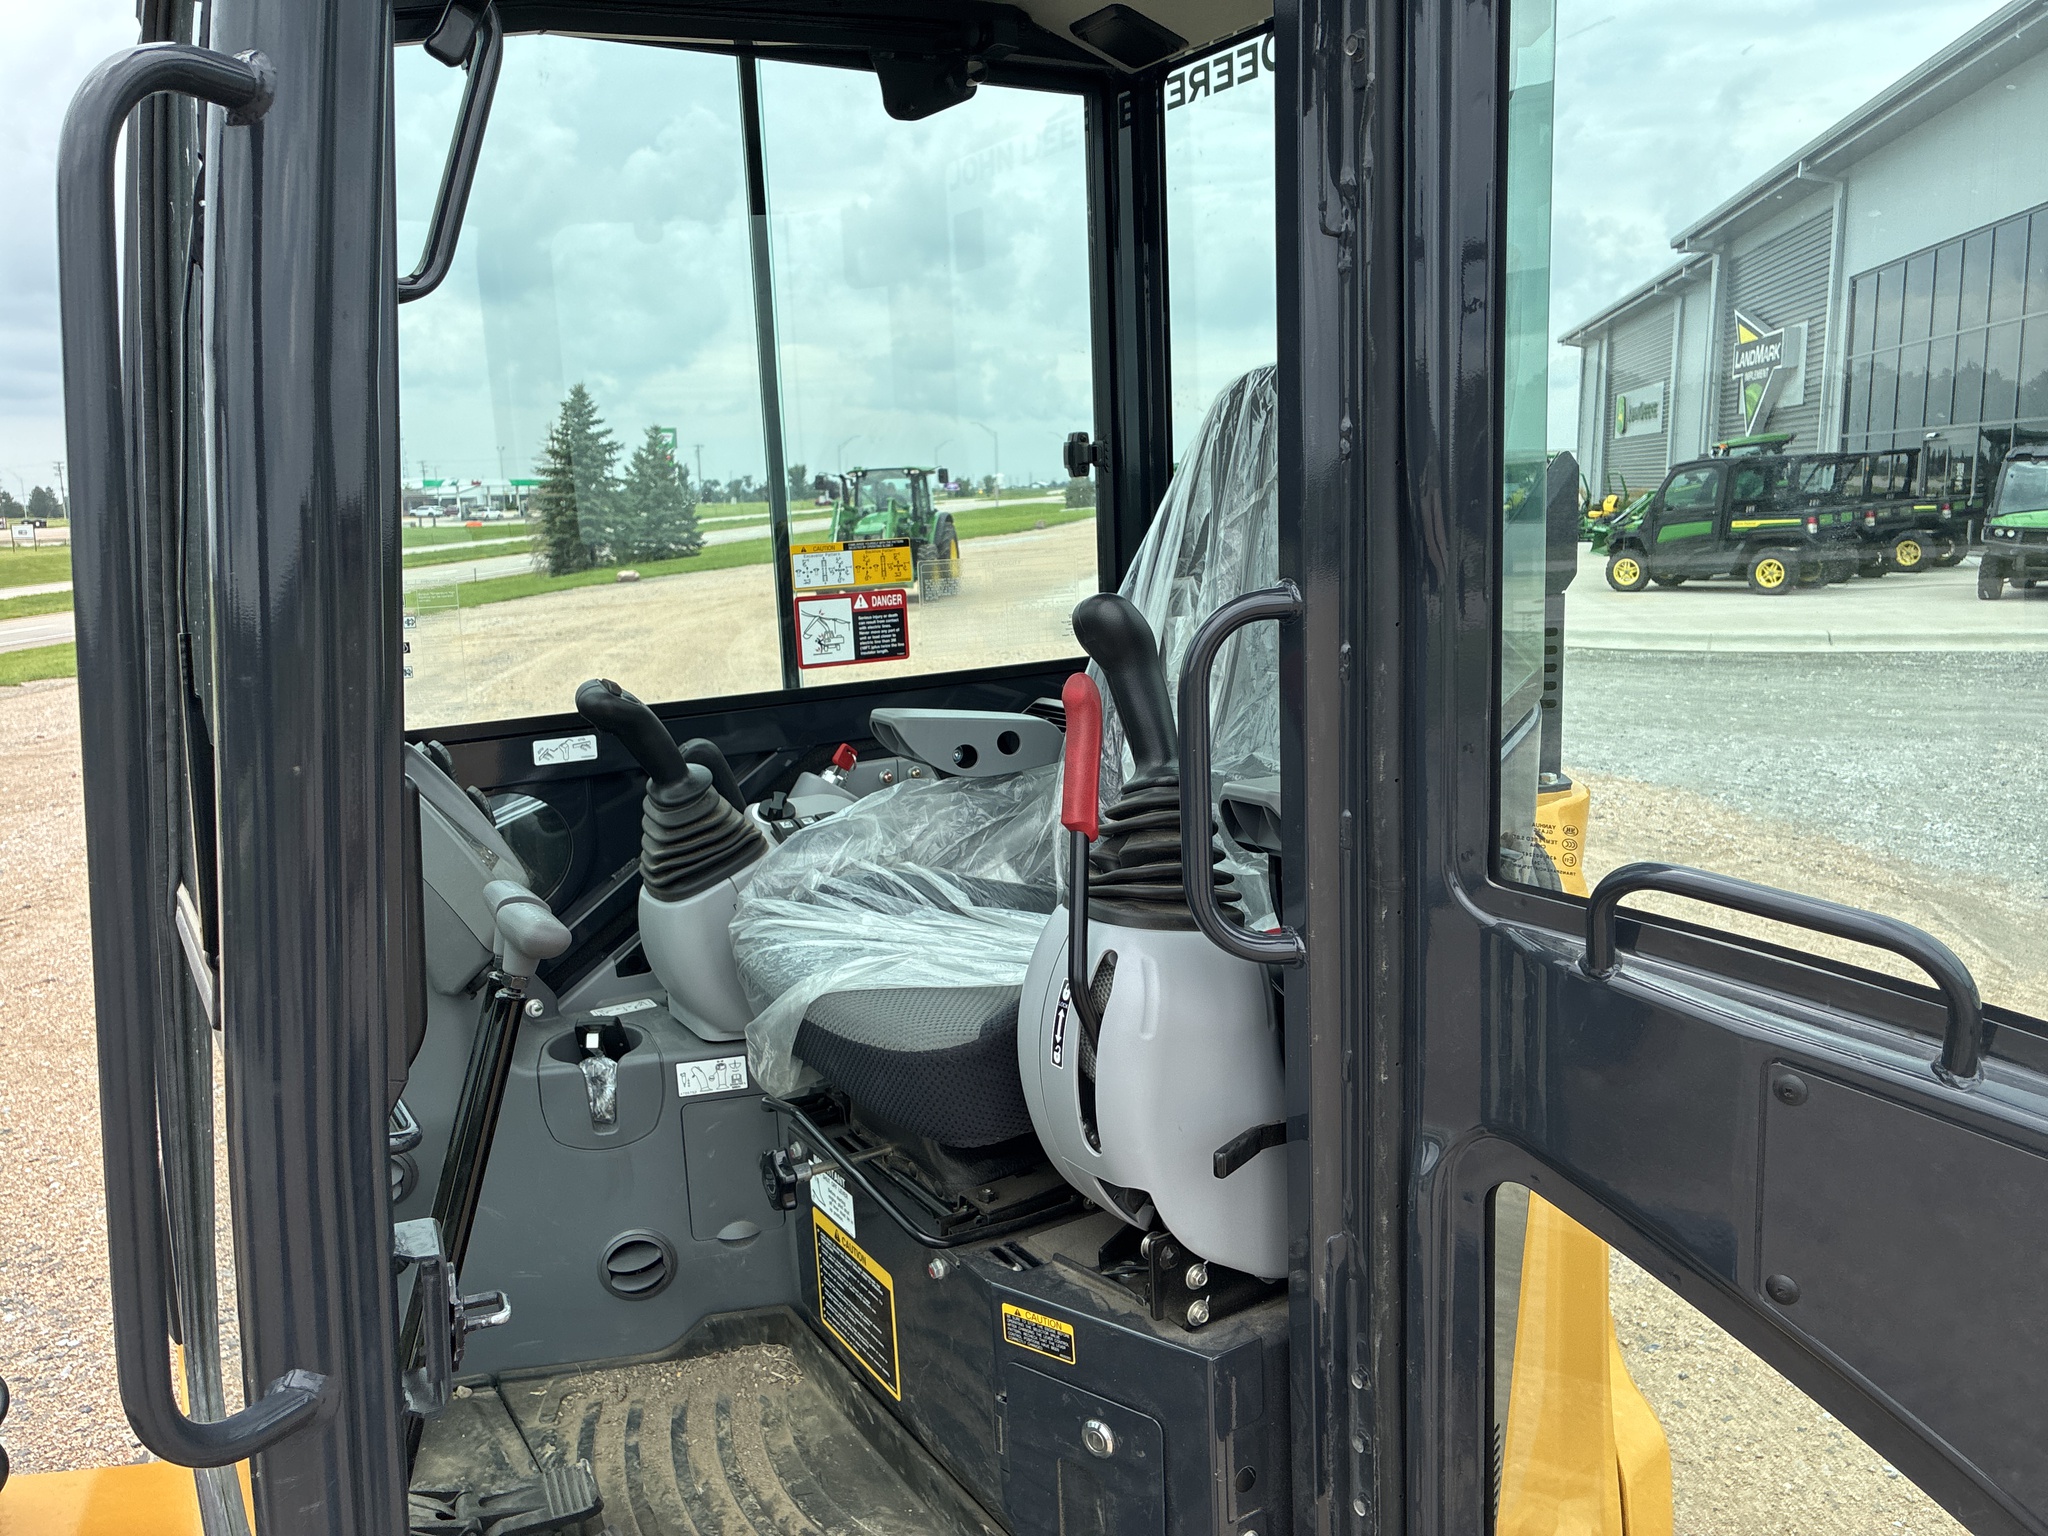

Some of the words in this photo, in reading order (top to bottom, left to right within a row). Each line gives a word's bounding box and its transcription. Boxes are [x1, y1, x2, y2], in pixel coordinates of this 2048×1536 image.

[871, 594, 902, 607] DANGER
[841, 1236, 867, 1266] CAUTION
[1025, 1312, 1062, 1330] CAUTION
